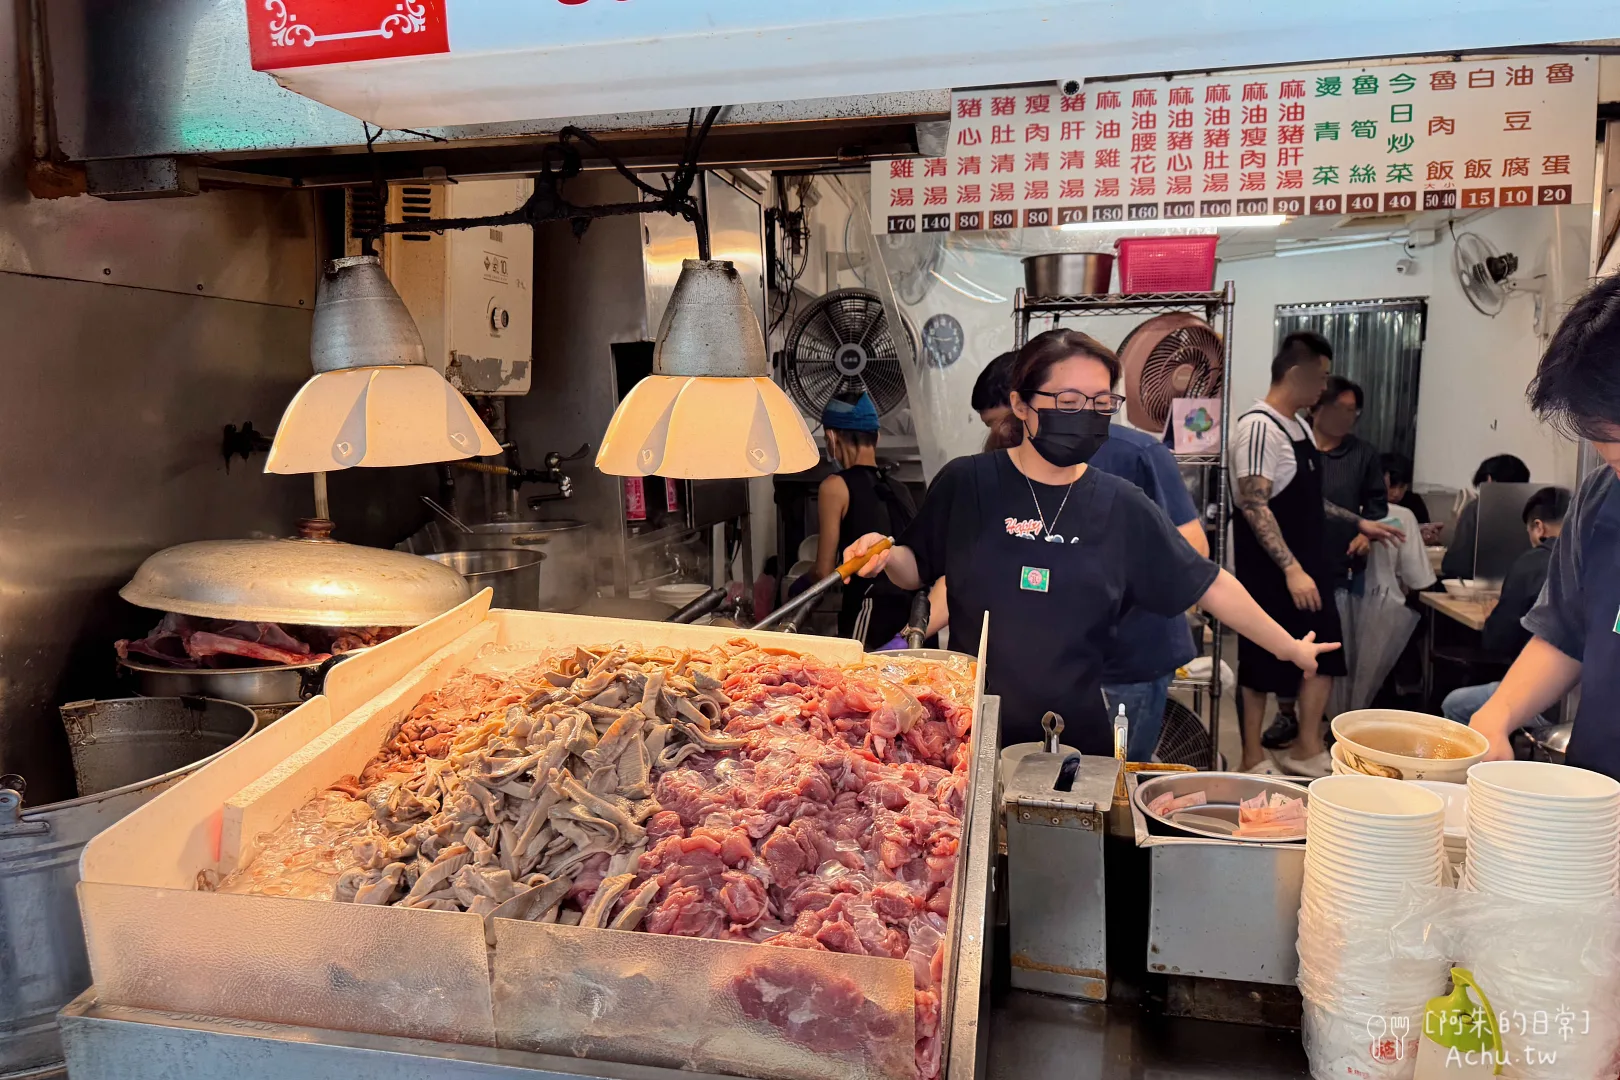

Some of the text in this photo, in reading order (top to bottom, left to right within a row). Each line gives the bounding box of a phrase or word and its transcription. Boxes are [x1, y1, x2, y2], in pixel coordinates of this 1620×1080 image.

[1385, 73, 1417, 183] 今日炒菜
[1426, 70, 1457, 181] 魯肉飯
[1502, 65, 1534, 177] 油豆腐
[1239, 82, 1268, 191] 麻油瘦肉湯
[1276, 79, 1306, 190] 麻油豬肝湯
[1312, 76, 1342, 185] 燙青菜
[1349, 75, 1379, 184] 魯筍絲
[1059, 92, 1086, 198] 豬肝清湯
[1094, 91, 1121, 198] 麻油雞湯
[1130, 88, 1157, 196] 麻油腰花湯
[1166, 86, 1194, 195] 麻油豬心湯
[1202, 84, 1231, 193] 麻油豬肚湯
[957, 98, 982, 204] 豬心清湯
[990, 96, 1016, 202] 豬肚清湯
[1024, 94, 1050, 200] 瘦肉清湯
[1389, 195, 1411, 208] 40
[1426, 194, 1439, 207] 50
[1442, 193, 1456, 206] 40
[1468, 192, 1491, 205] 15
[1505, 190, 1528, 203] 10
[1543, 188, 1566, 201] 20
[1202, 202, 1231, 216] 100
[1238, 201, 1268, 215] 100
[1278, 200, 1300, 213] 90
[1315, 198, 1337, 211] 40
[1351, 197, 1373, 209] 40
[1028, 211, 1048, 224] 80
[1063, 209, 1083, 222] 70
[1093, 208, 1122, 221] 180
[1130, 206, 1158, 220] 160
[1165, 204, 1194, 217] 100
[889, 218, 915, 231] 170
[923, 216, 950, 229] 140
[959, 214, 979, 227] 80
[993, 213, 1013, 226] 80
[1004, 517, 1043, 536] Happy
